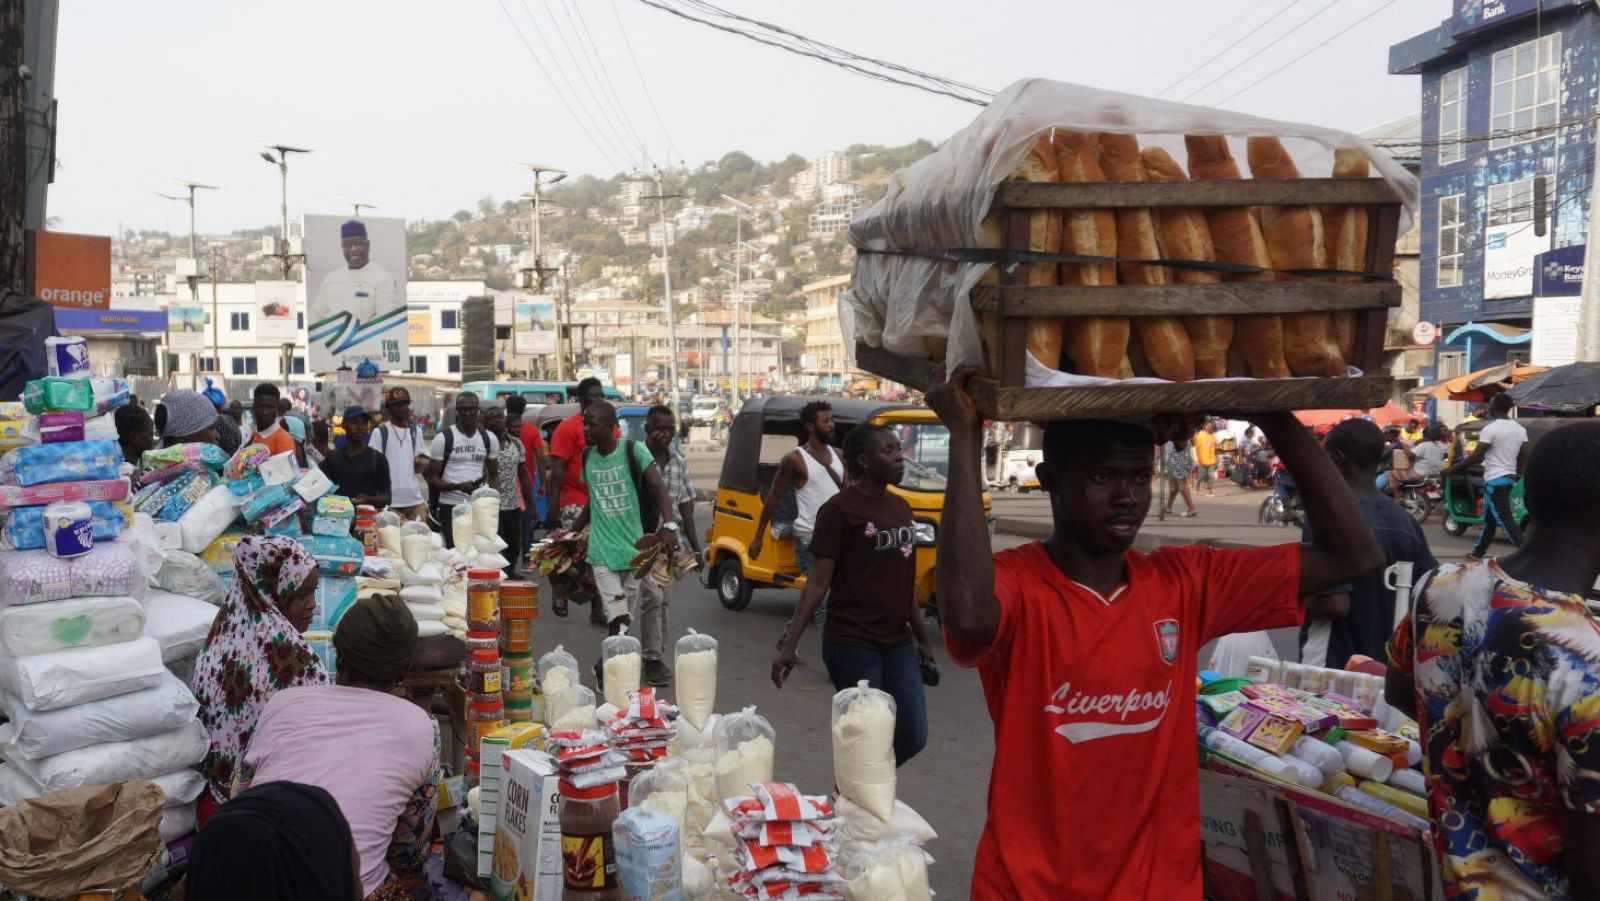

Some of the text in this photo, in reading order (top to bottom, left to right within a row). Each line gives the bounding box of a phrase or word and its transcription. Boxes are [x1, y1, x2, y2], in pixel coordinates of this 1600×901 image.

[1483, 3, 1506, 20] Bank
[41, 288, 103, 306] orange
[382, 339, 399, 351] TOK
[452, 445, 476, 454] OLICE
[507, 778, 530, 814] CORN
[504, 802, 527, 834] FLAKES
